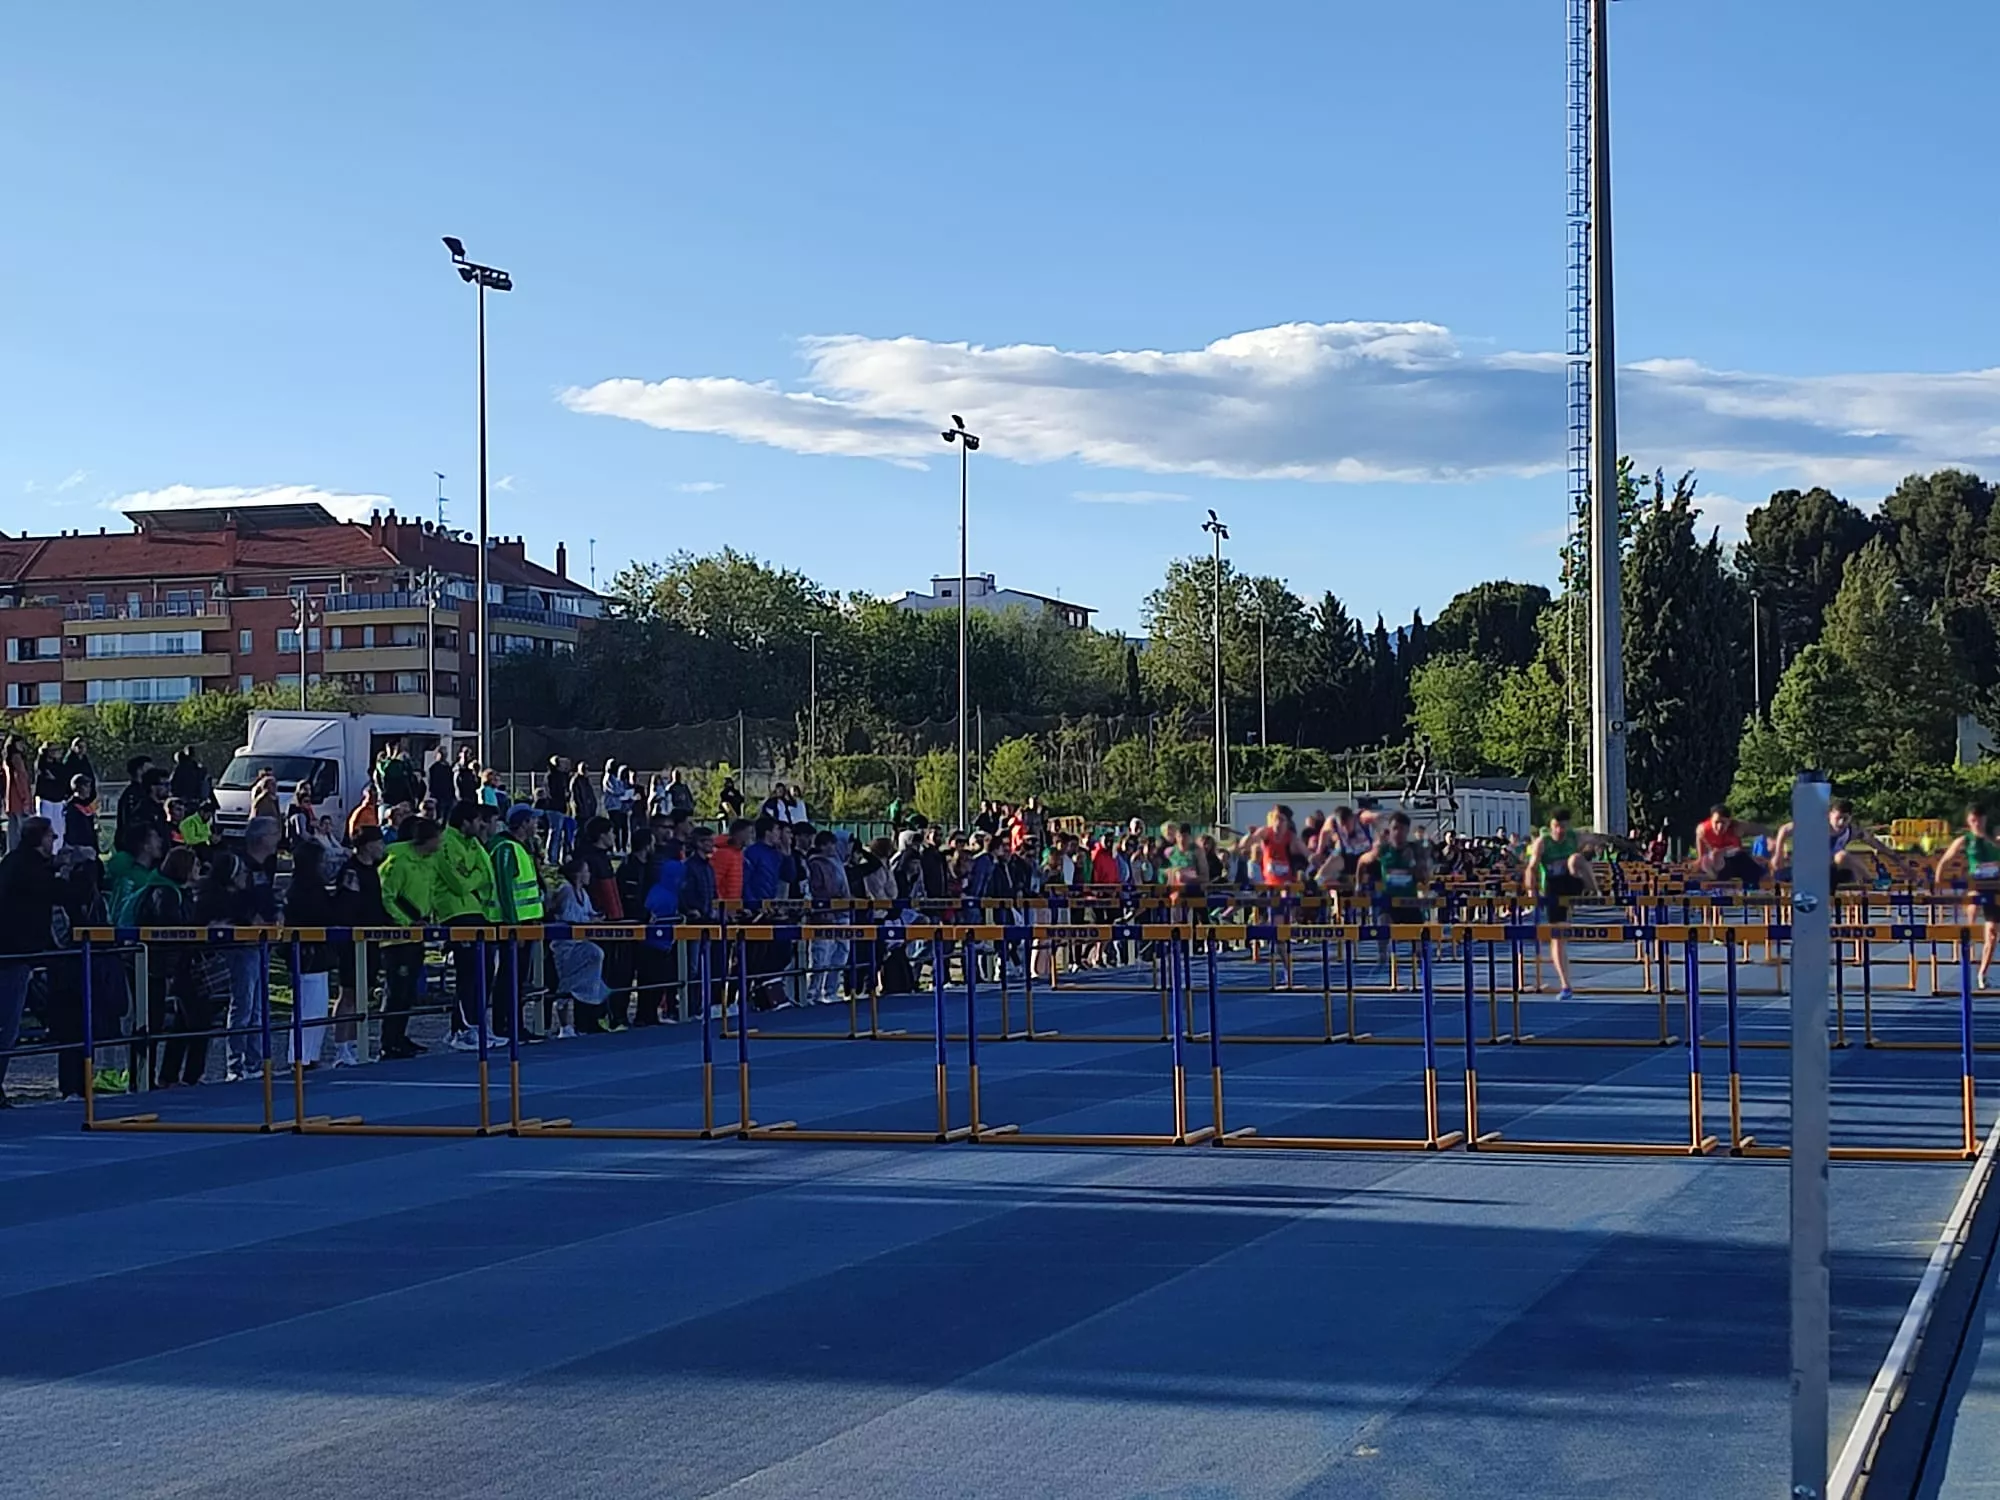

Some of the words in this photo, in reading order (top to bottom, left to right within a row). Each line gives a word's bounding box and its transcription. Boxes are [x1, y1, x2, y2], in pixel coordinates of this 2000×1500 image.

[1047, 928, 1099, 938] MONDO
[1291, 928, 1344, 938] MONDO
[1830, 928, 1876, 938] ONDO
